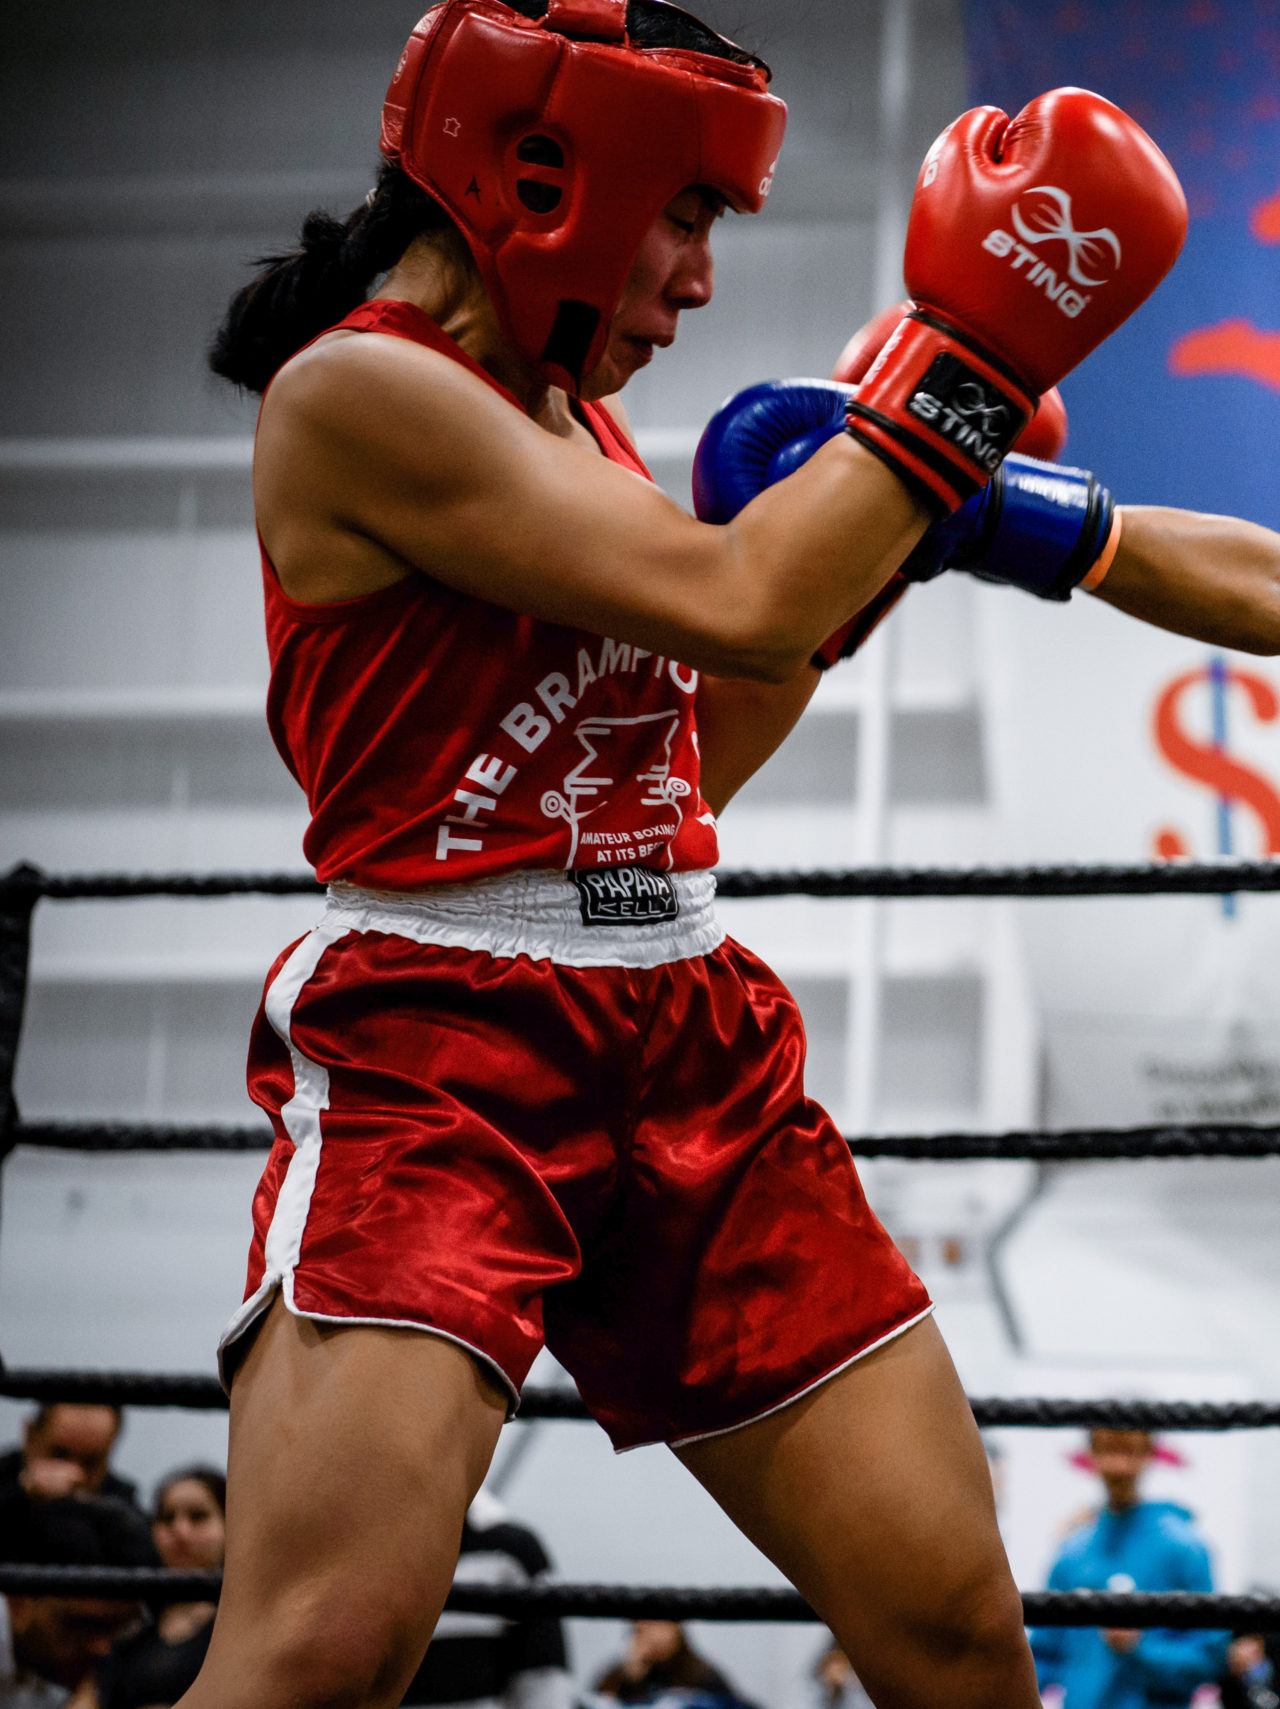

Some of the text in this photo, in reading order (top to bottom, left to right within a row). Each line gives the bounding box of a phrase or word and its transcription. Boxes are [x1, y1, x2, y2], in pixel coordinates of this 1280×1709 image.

[981, 229, 1088, 318] STING
[909, 391, 1002, 474] STING
[435, 753, 518, 861] THE
[580, 824, 676, 845] AMATEUR BOXING
[597, 850, 612, 863] AT
[615, 847, 637, 861] ITS
[597, 896, 673, 916] KELLY
